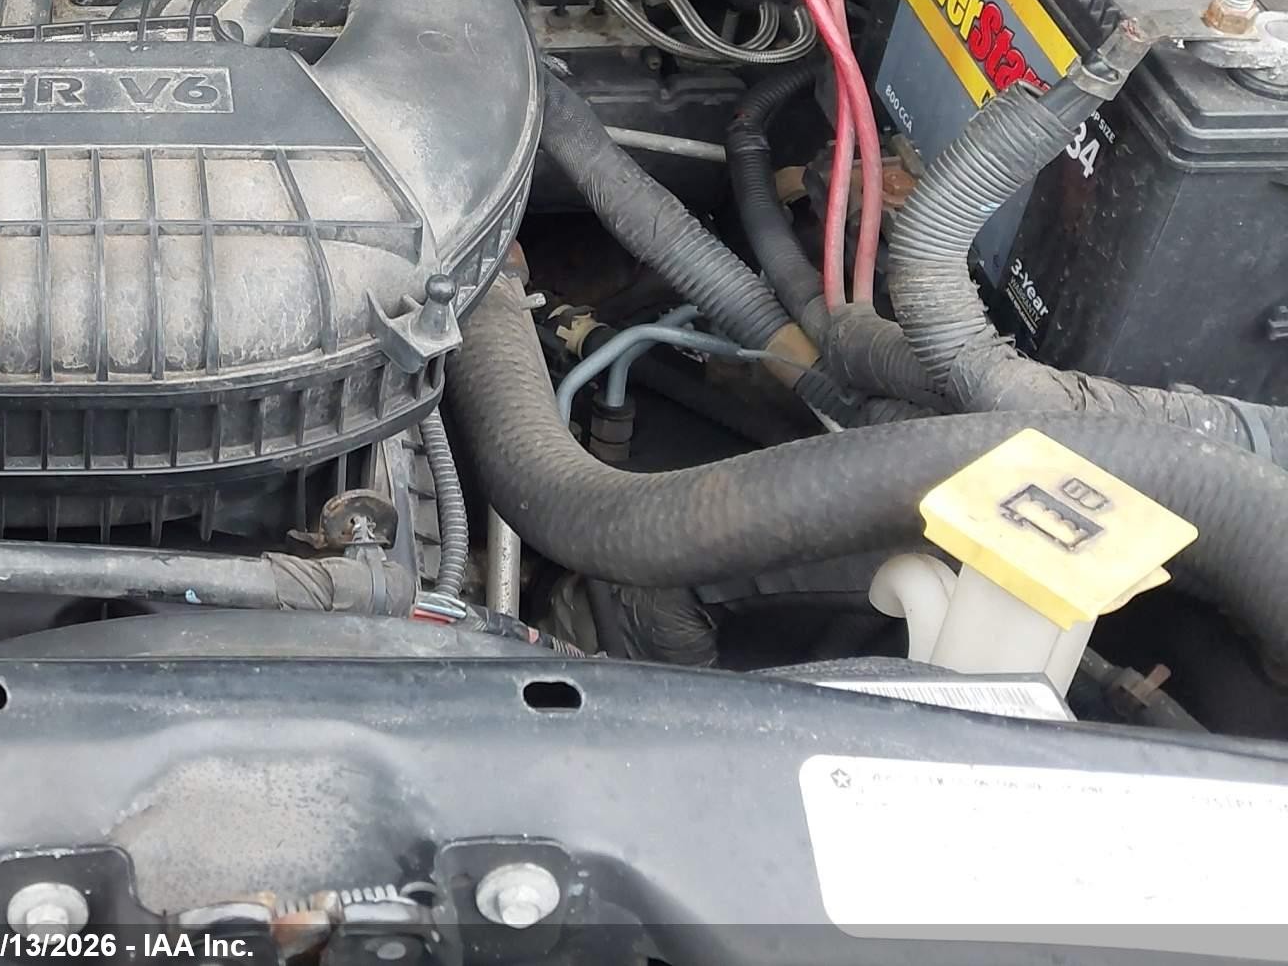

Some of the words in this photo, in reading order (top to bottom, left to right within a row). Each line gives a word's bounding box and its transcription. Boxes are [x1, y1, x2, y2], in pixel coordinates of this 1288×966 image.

[117, 75, 221, 106] V6
[885, 84, 900, 110] 800
[899, 107, 913, 134] CCA
[1066, 121, 1100, 178] 34
[1099, 119, 1116, 144] SIZE
[1011, 258, 1049, 316] 3-Year
